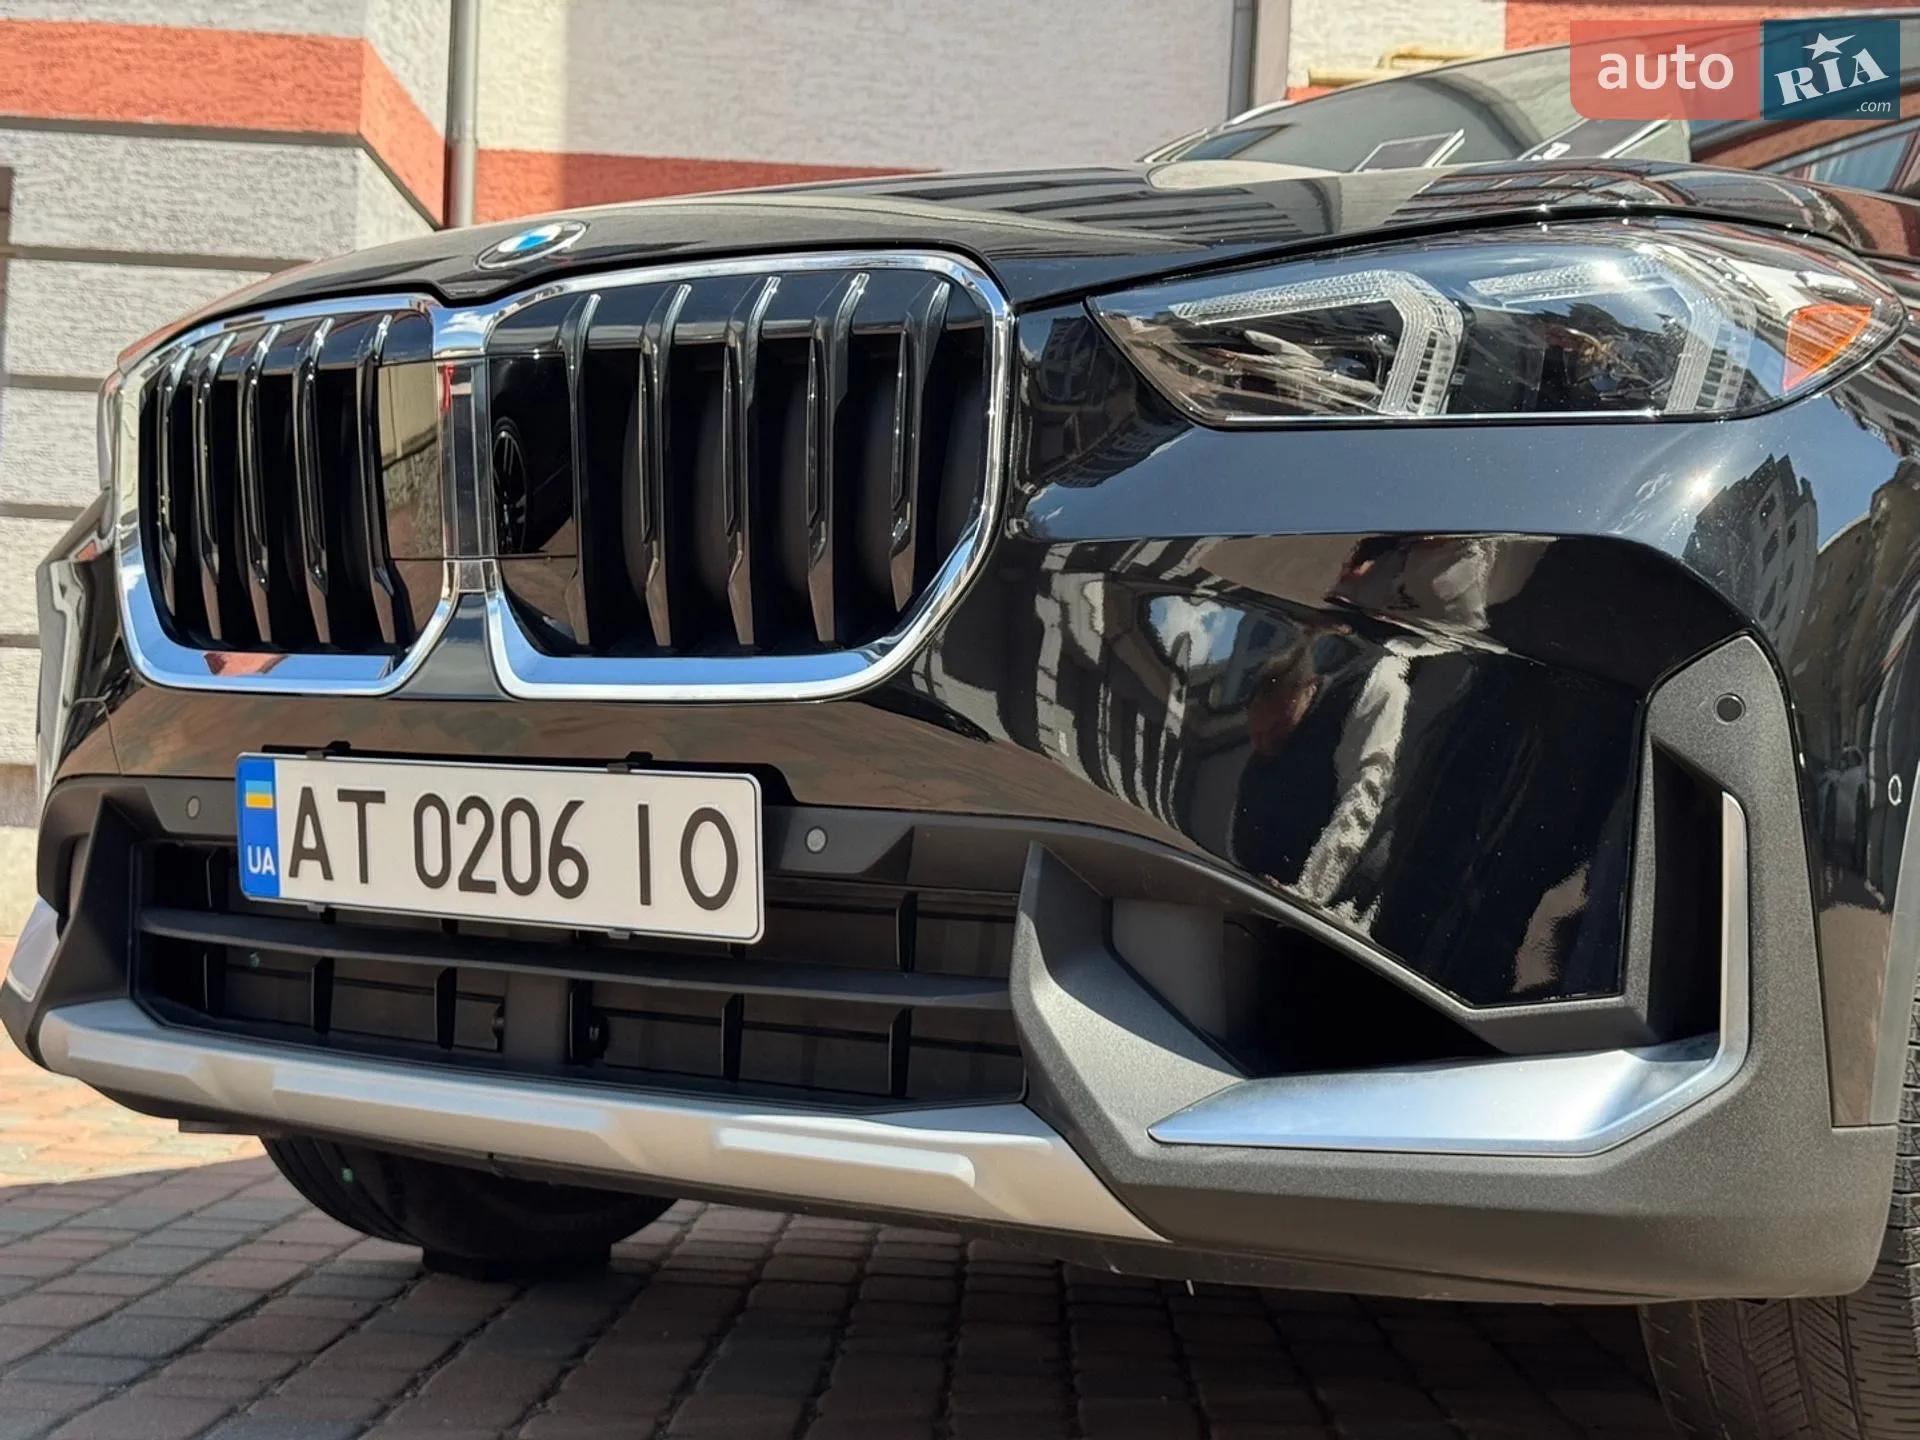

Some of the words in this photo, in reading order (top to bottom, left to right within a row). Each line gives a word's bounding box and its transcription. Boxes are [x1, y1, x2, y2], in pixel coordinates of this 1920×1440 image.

[247, 845, 276, 876] UA
[289, 786, 386, 884] AT
[413, 793, 589, 899] 0206
[638, 804, 739, 911] IO
